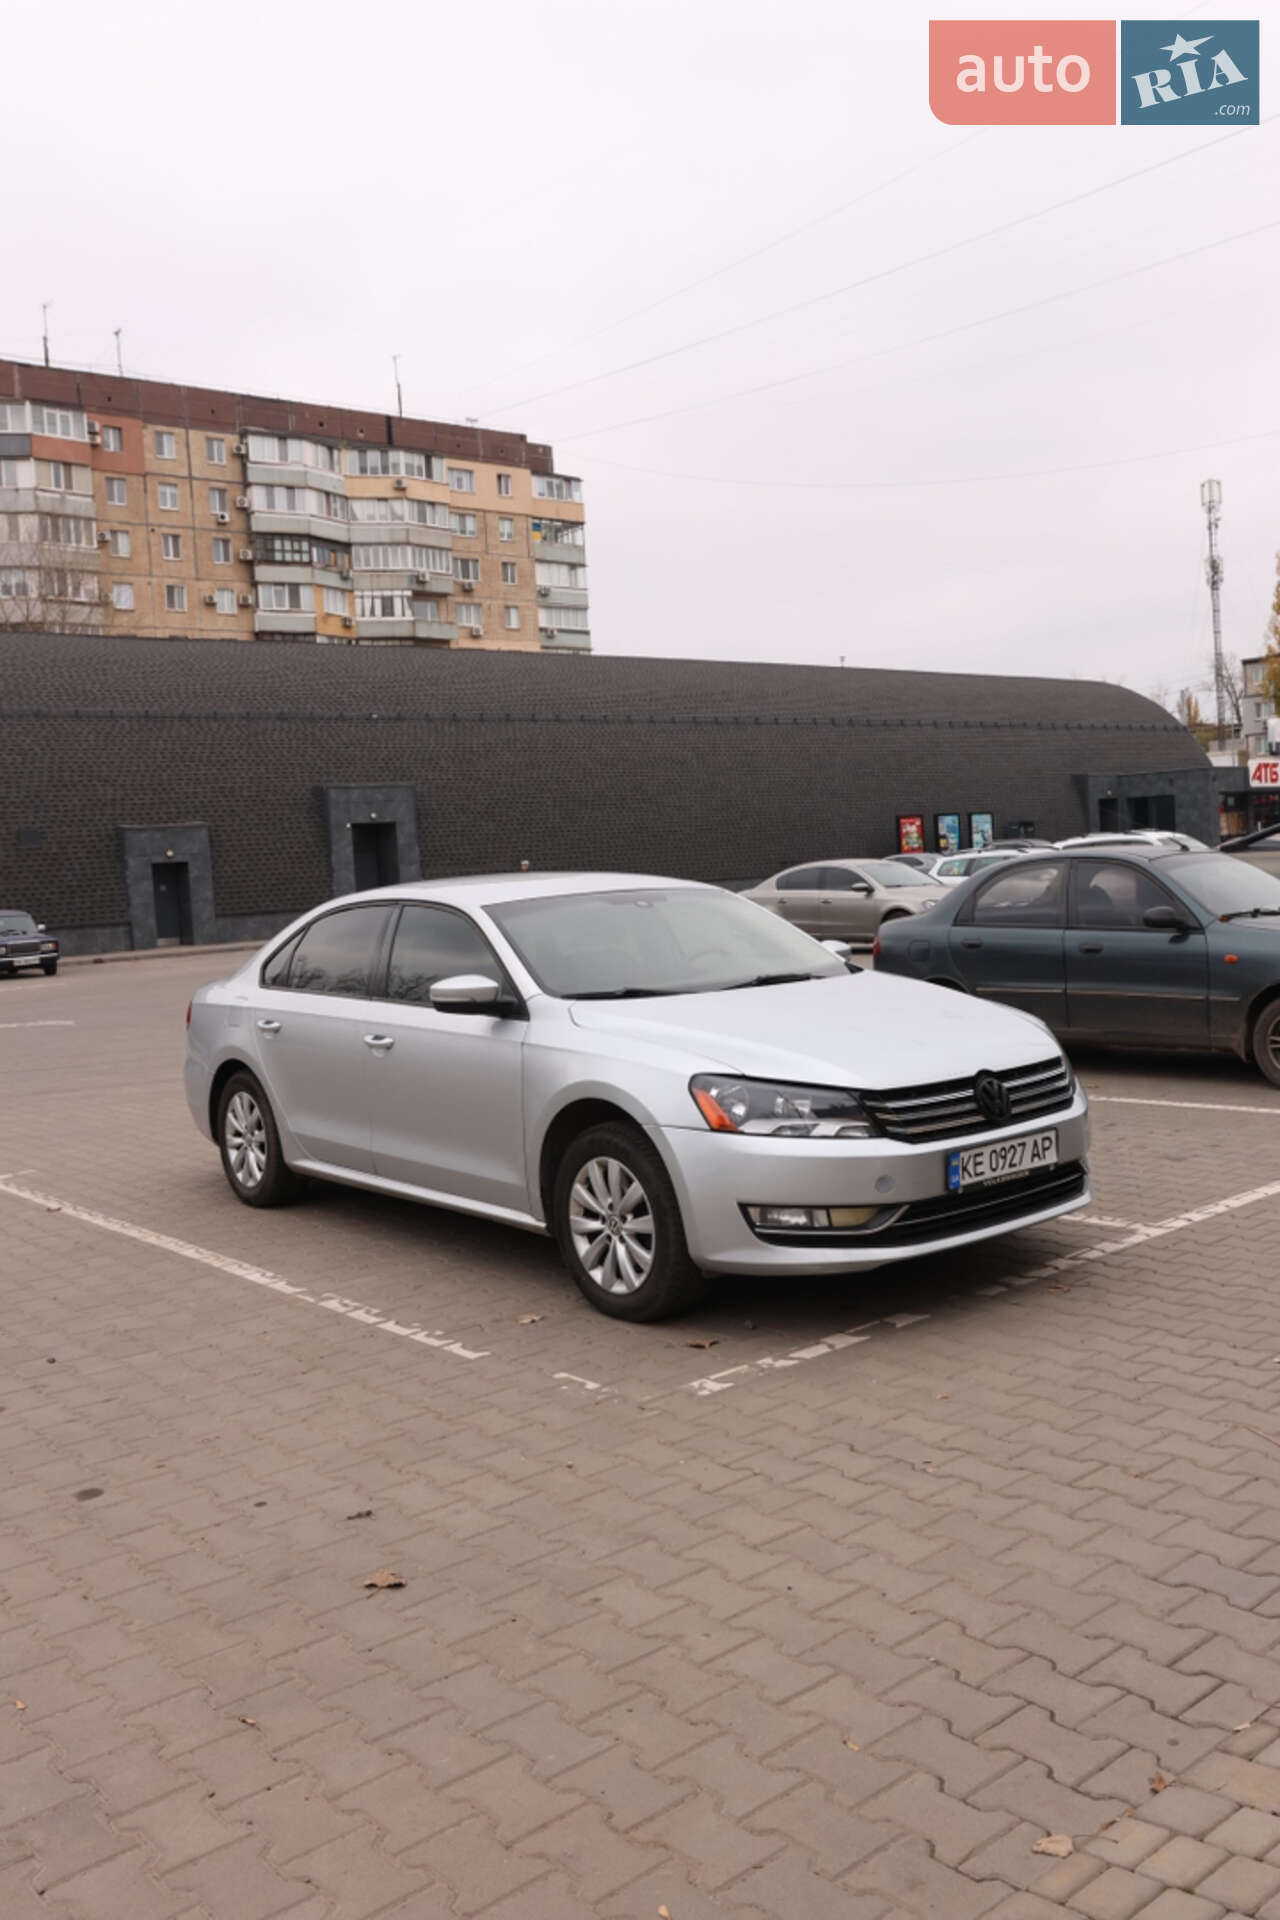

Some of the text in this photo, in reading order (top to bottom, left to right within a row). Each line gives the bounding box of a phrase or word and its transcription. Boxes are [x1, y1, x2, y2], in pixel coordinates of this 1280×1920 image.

[1252, 762, 1279, 783] АТБ
[961, 1152, 985, 1180] KE
[989, 1141, 1026, 1172] 0927
[1030, 1136, 1053, 1163] AP
